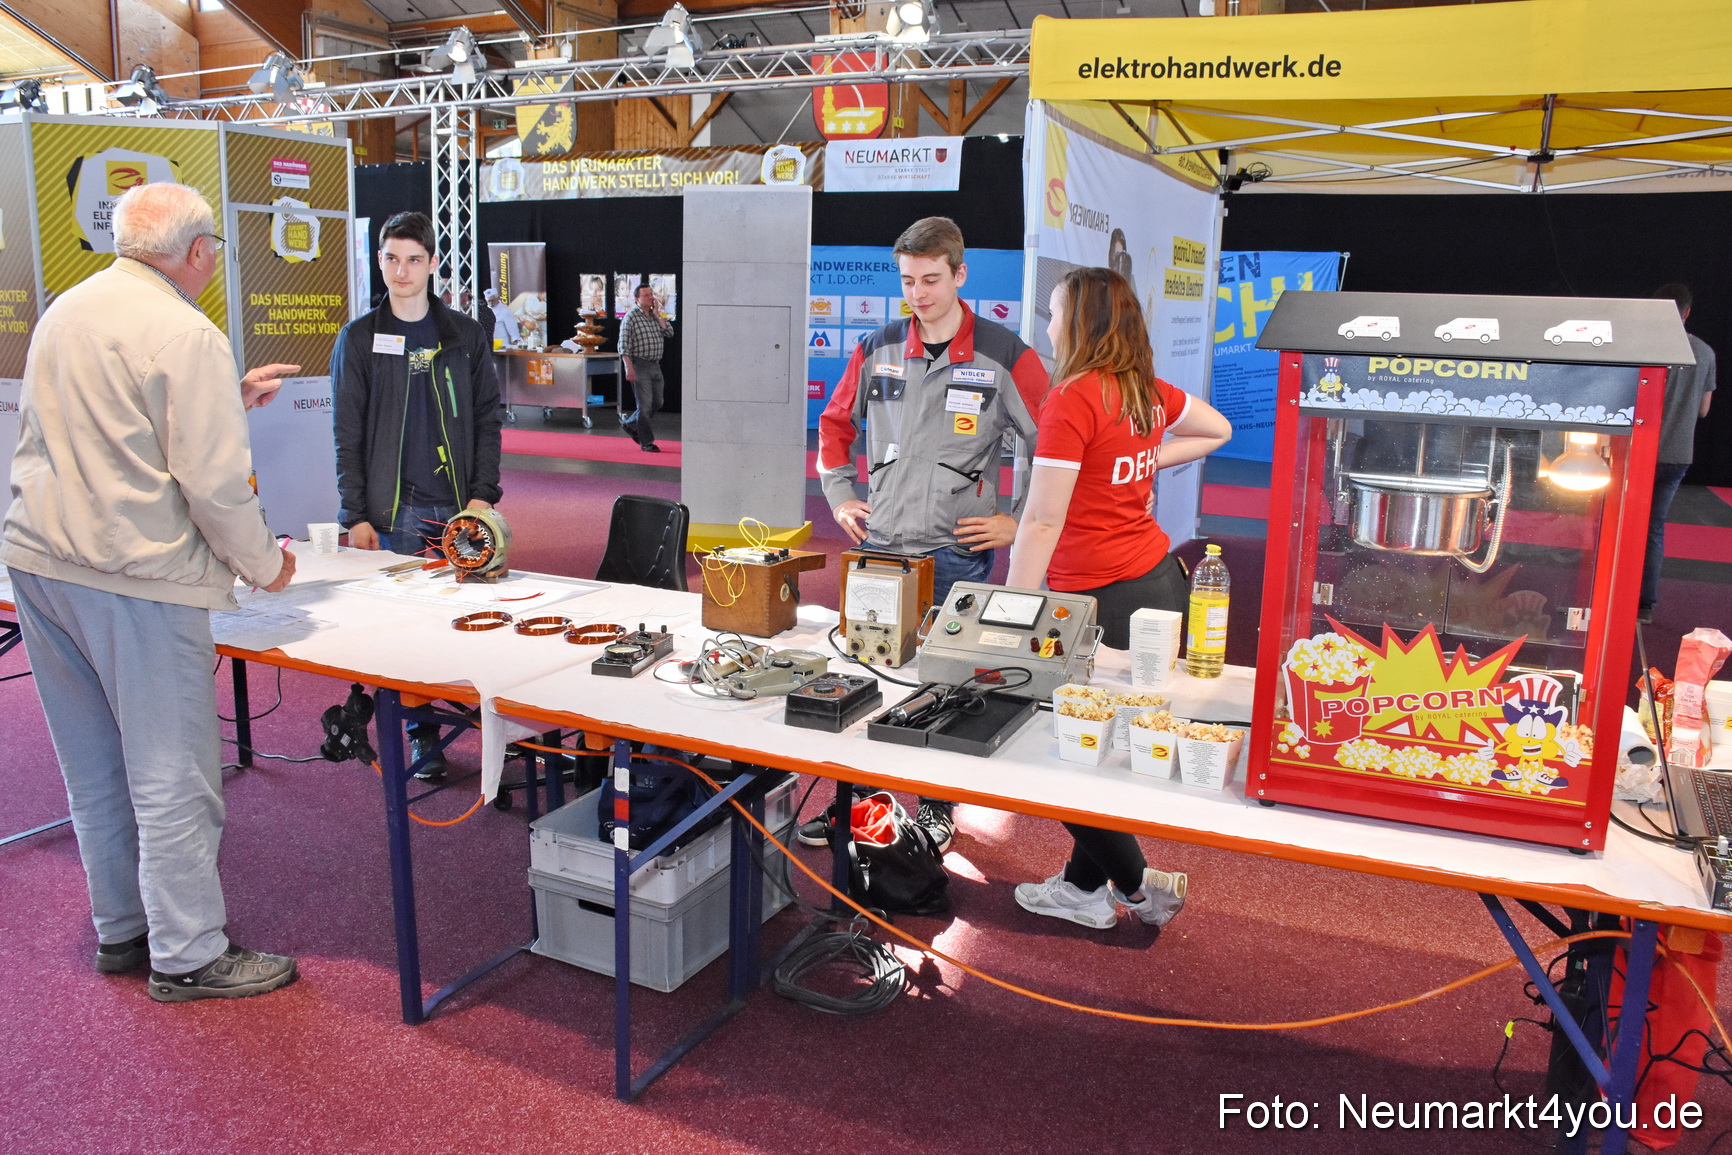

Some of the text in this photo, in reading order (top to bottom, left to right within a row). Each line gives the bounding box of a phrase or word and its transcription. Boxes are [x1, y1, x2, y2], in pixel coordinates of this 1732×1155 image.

[1078, 54, 1342, 78] elektrohandwerk.de
[845, 148, 931, 164] NEUMARKT
[543, 157, 662, 174] DAS NEUMARKTER
[543, 170, 739, 190] HANDWERK STELLT SICH VOR!
[288, 230, 308, 240] HAND
[288, 239, 308, 250] WERK
[828, 274, 875, 285] I.D.OPF.
[250, 293, 342, 306] DAS NEUMARKTER
[268, 308, 327, 320] HANDWERK
[9, 322, 28, 333] VOR!
[254, 322, 340, 335] STELLT SICH VOR!
[1368, 357, 1528, 380] POPCORN
[1404, 376, 1434, 385] catering
[294, 398, 331, 410] NEUMAR
[1321, 687, 1506, 719] POPCORN
